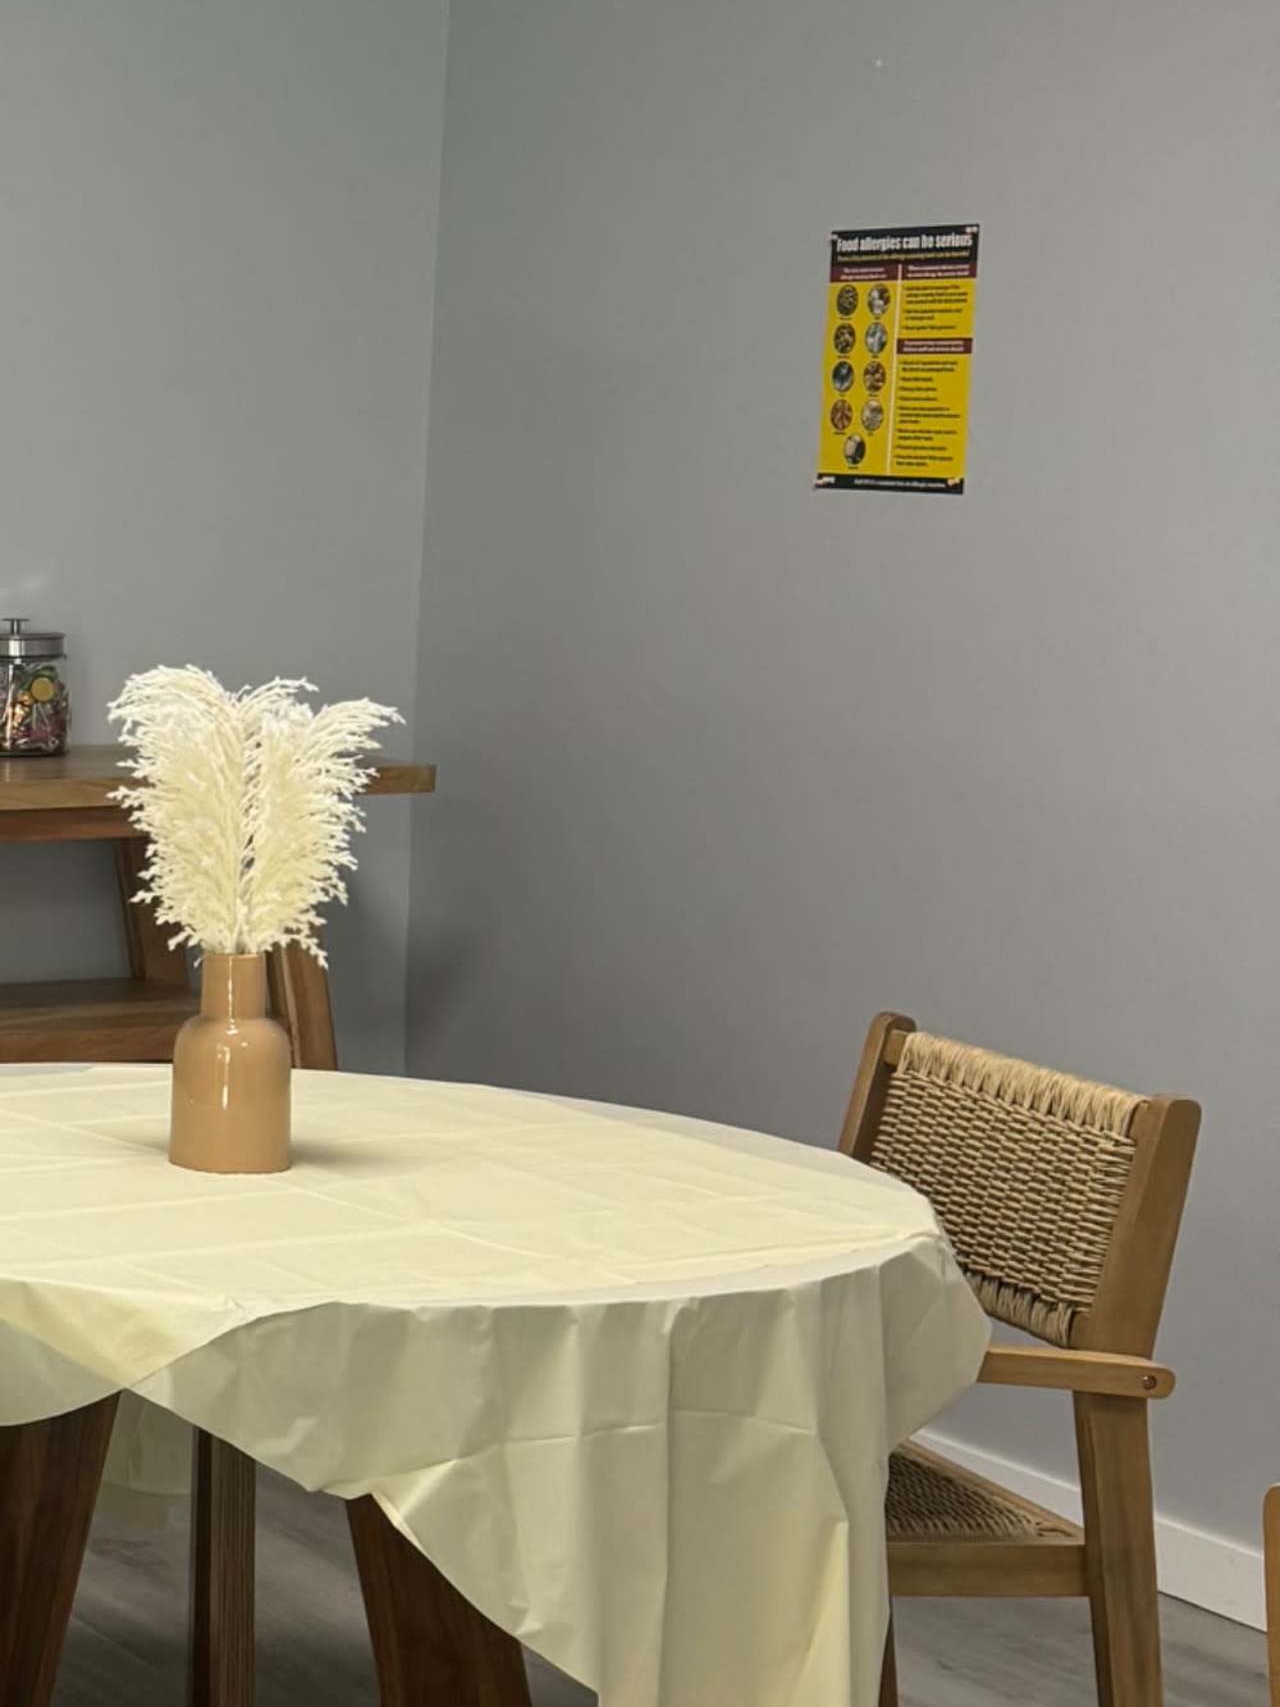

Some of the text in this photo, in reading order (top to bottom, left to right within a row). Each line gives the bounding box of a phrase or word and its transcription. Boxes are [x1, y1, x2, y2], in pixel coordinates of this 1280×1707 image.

[836, 233, 972, 252] Food allergies can be serious
